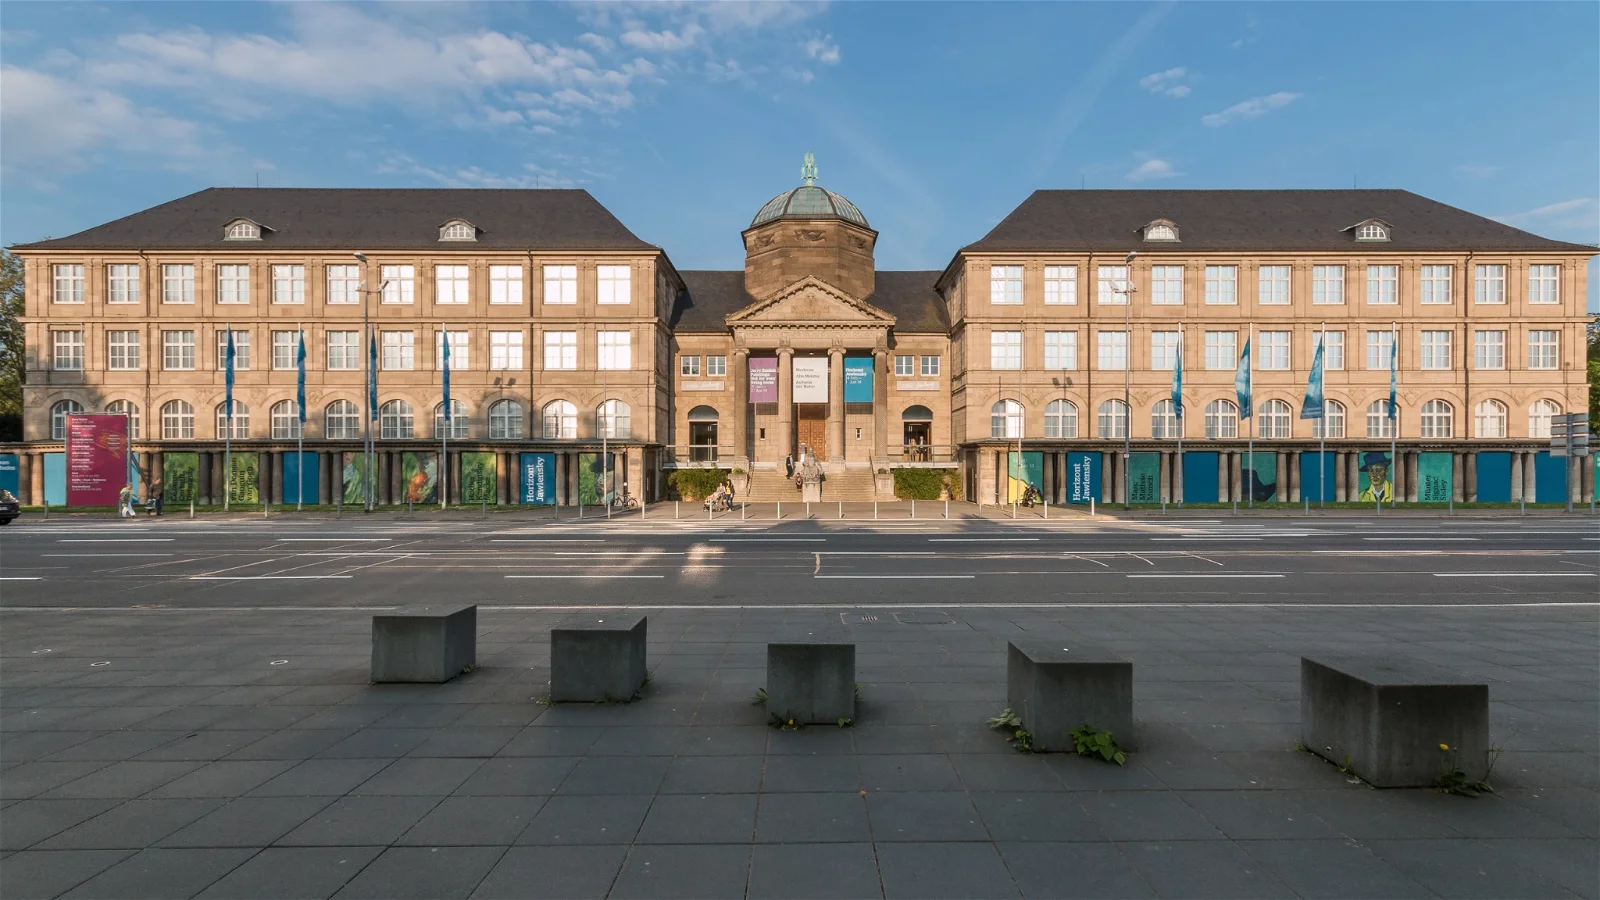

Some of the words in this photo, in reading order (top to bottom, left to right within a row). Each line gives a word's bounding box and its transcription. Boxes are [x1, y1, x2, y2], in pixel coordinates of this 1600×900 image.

[246, 466, 254, 485] Gogh
[526, 464, 534, 502] Horizont
[536, 456, 545, 502] Jawlensky
[1073, 463, 1081, 501] Horizont
[1082, 455, 1092, 501] Jawlensky
[1432, 476, 1440, 501] Signac
[1440, 479, 1448, 501] Sisley
